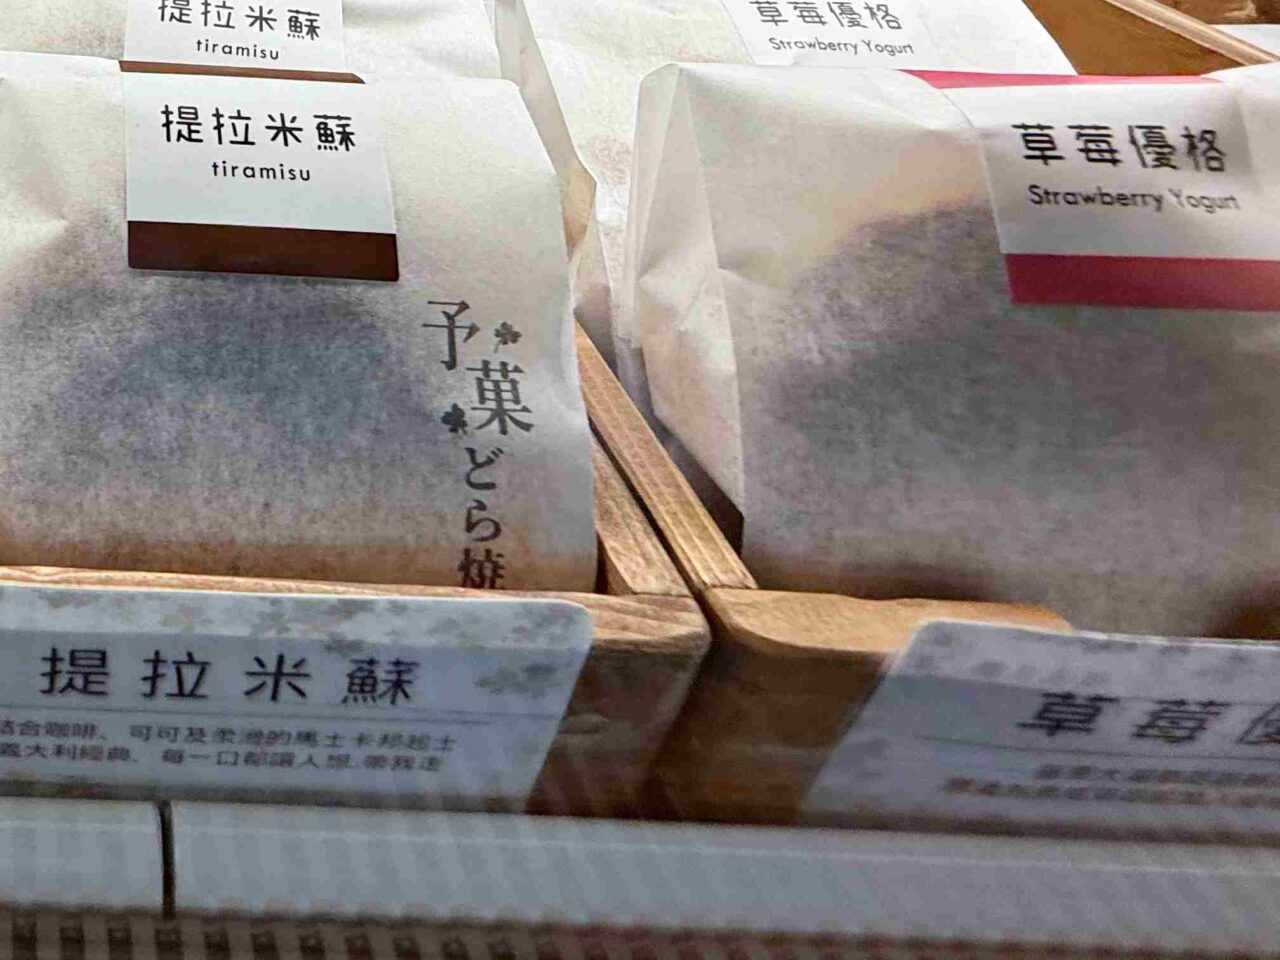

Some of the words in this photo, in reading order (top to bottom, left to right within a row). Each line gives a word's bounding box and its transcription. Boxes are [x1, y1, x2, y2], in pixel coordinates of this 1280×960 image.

[749, 0, 902, 30] 草莓優格
[196, 39, 280, 60] tiramisu
[768, 37, 858, 54] Strawberry
[862, 39, 914, 57] Yogurt
[160, 103, 356, 152] 提拉米蘇
[1011, 124, 1228, 172] 草莓優格
[212, 160, 311, 181] tiramisu
[1028, 184, 1163, 212] Strawberry
[1167, 187, 1241, 214] Yogurt
[40, 646, 420, 706] 提拉米蘇
